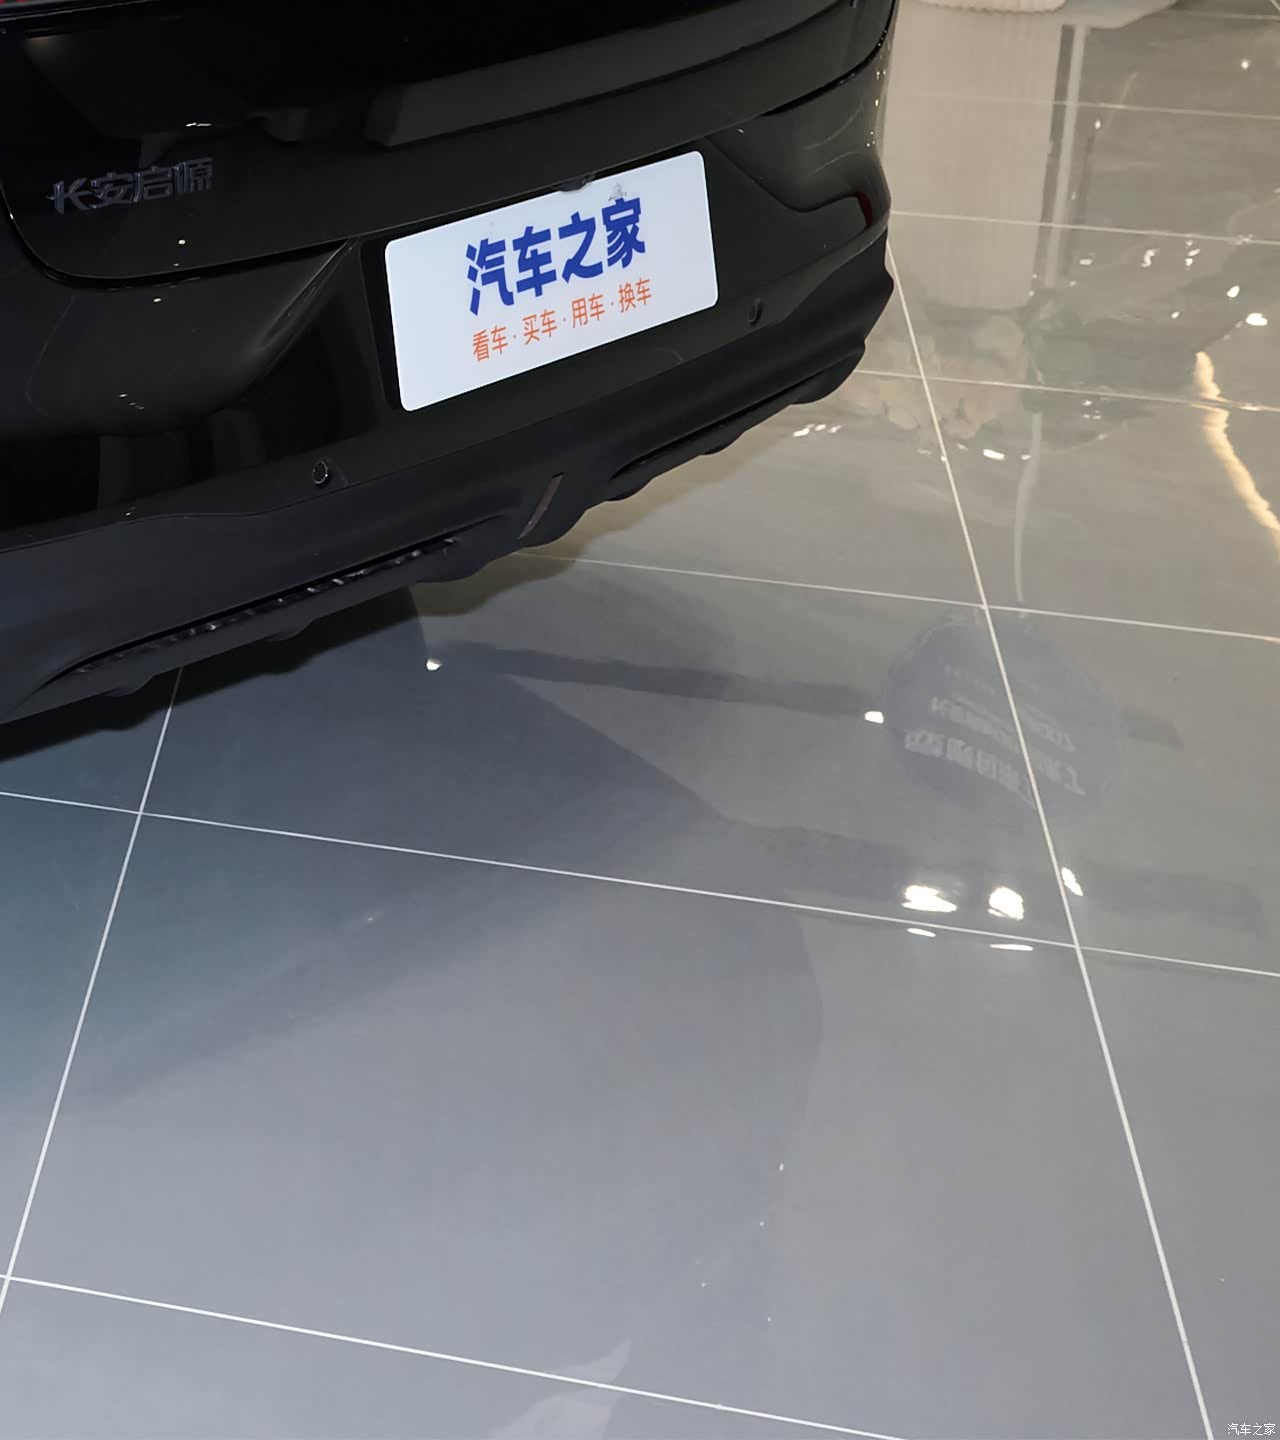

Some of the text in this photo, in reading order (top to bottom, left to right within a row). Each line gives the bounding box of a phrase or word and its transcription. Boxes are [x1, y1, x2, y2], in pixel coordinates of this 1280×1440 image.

[46, 157, 214, 214] 长安启源
[465, 197, 647, 317] 汽车之家
